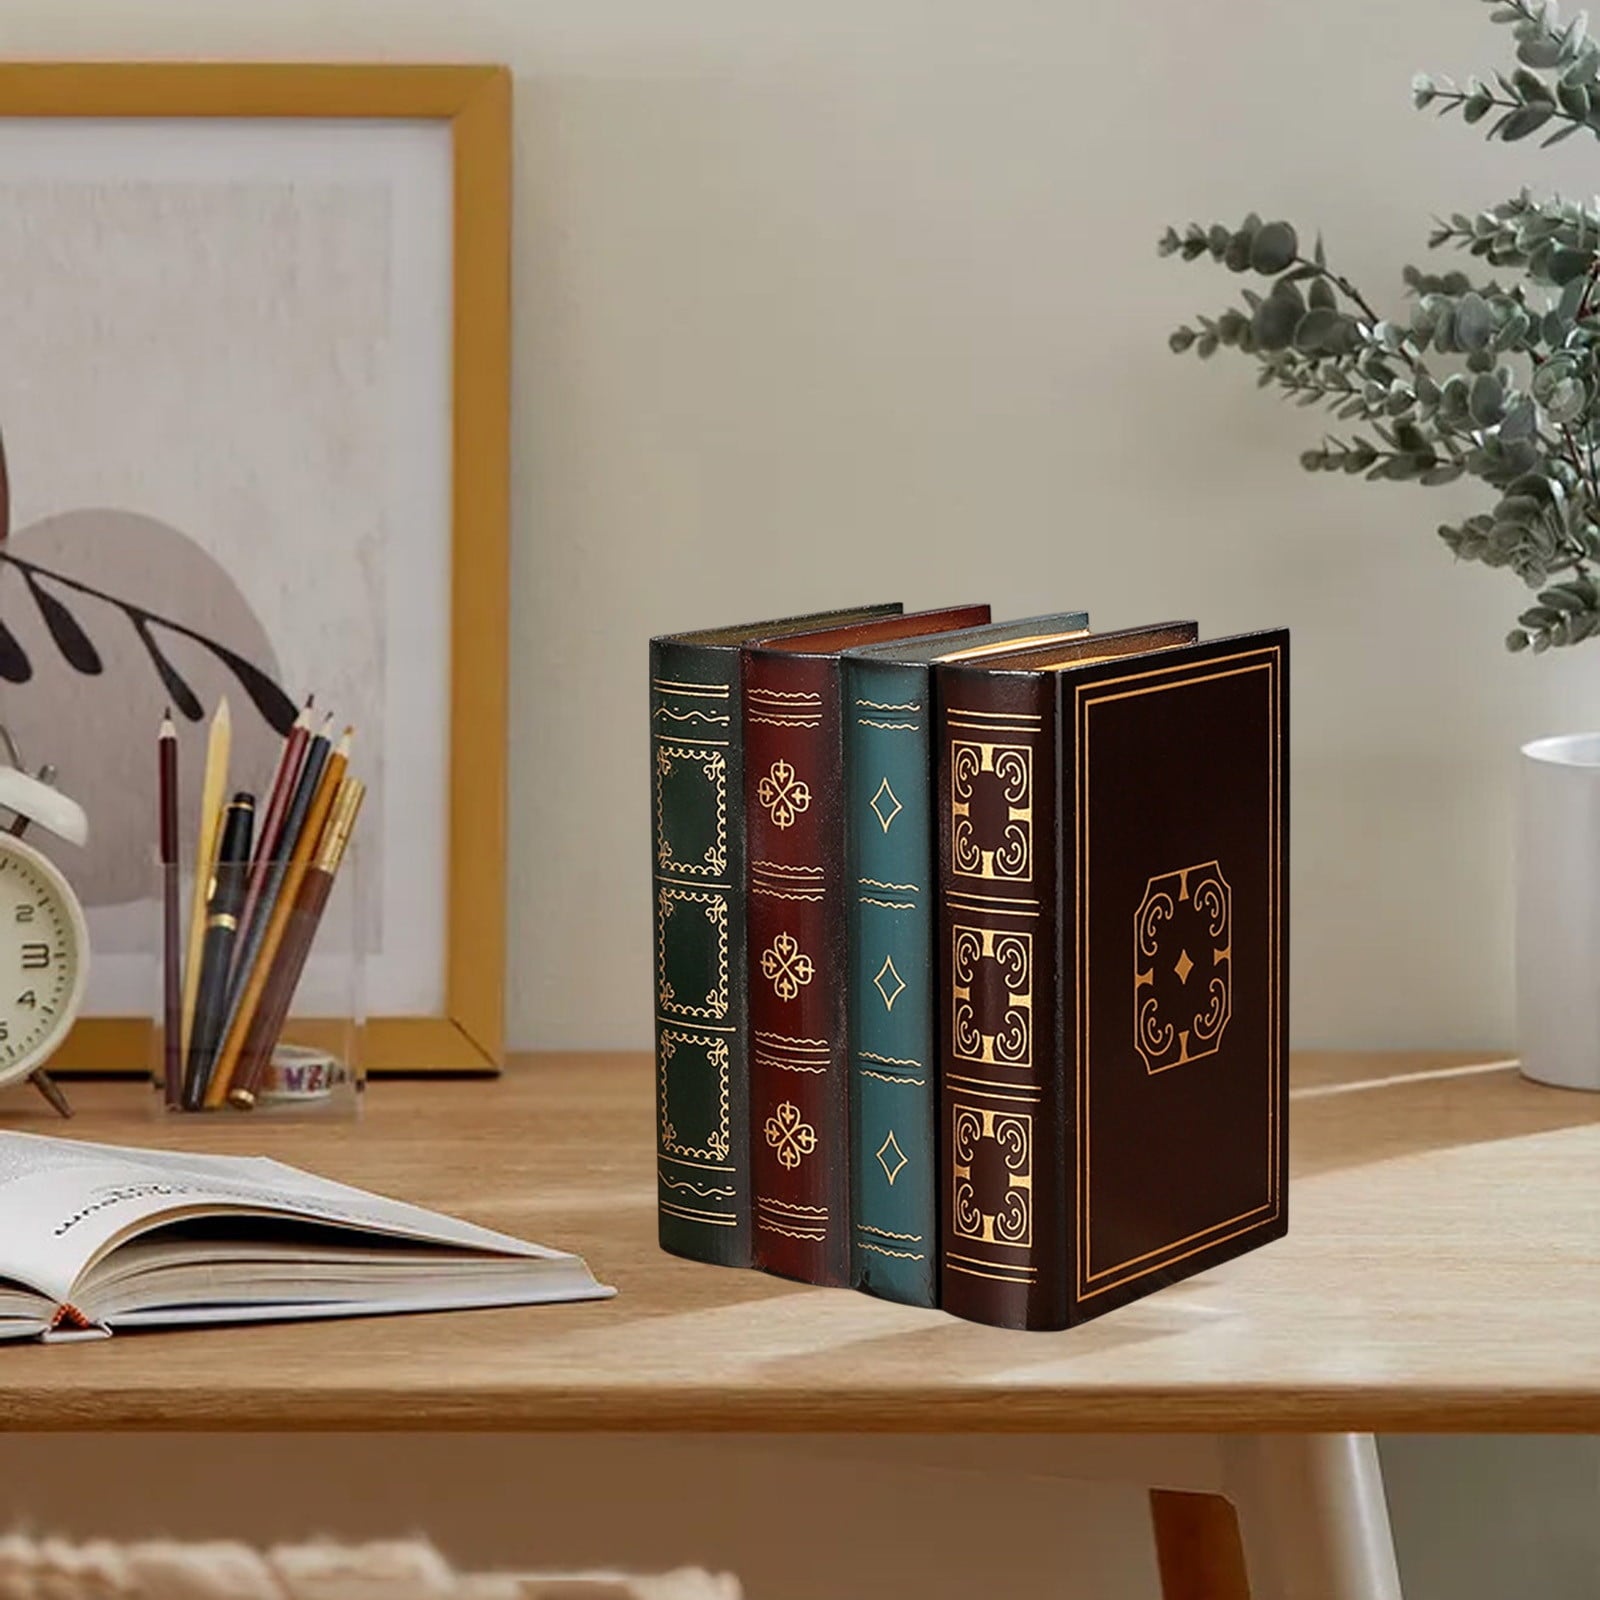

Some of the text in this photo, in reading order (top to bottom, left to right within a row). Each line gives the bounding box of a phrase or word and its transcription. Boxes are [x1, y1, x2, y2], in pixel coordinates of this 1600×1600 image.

[16, 904, 34, 922] 2
[22, 944, 49, 968] 3
[17, 990, 35, 1009] 4
